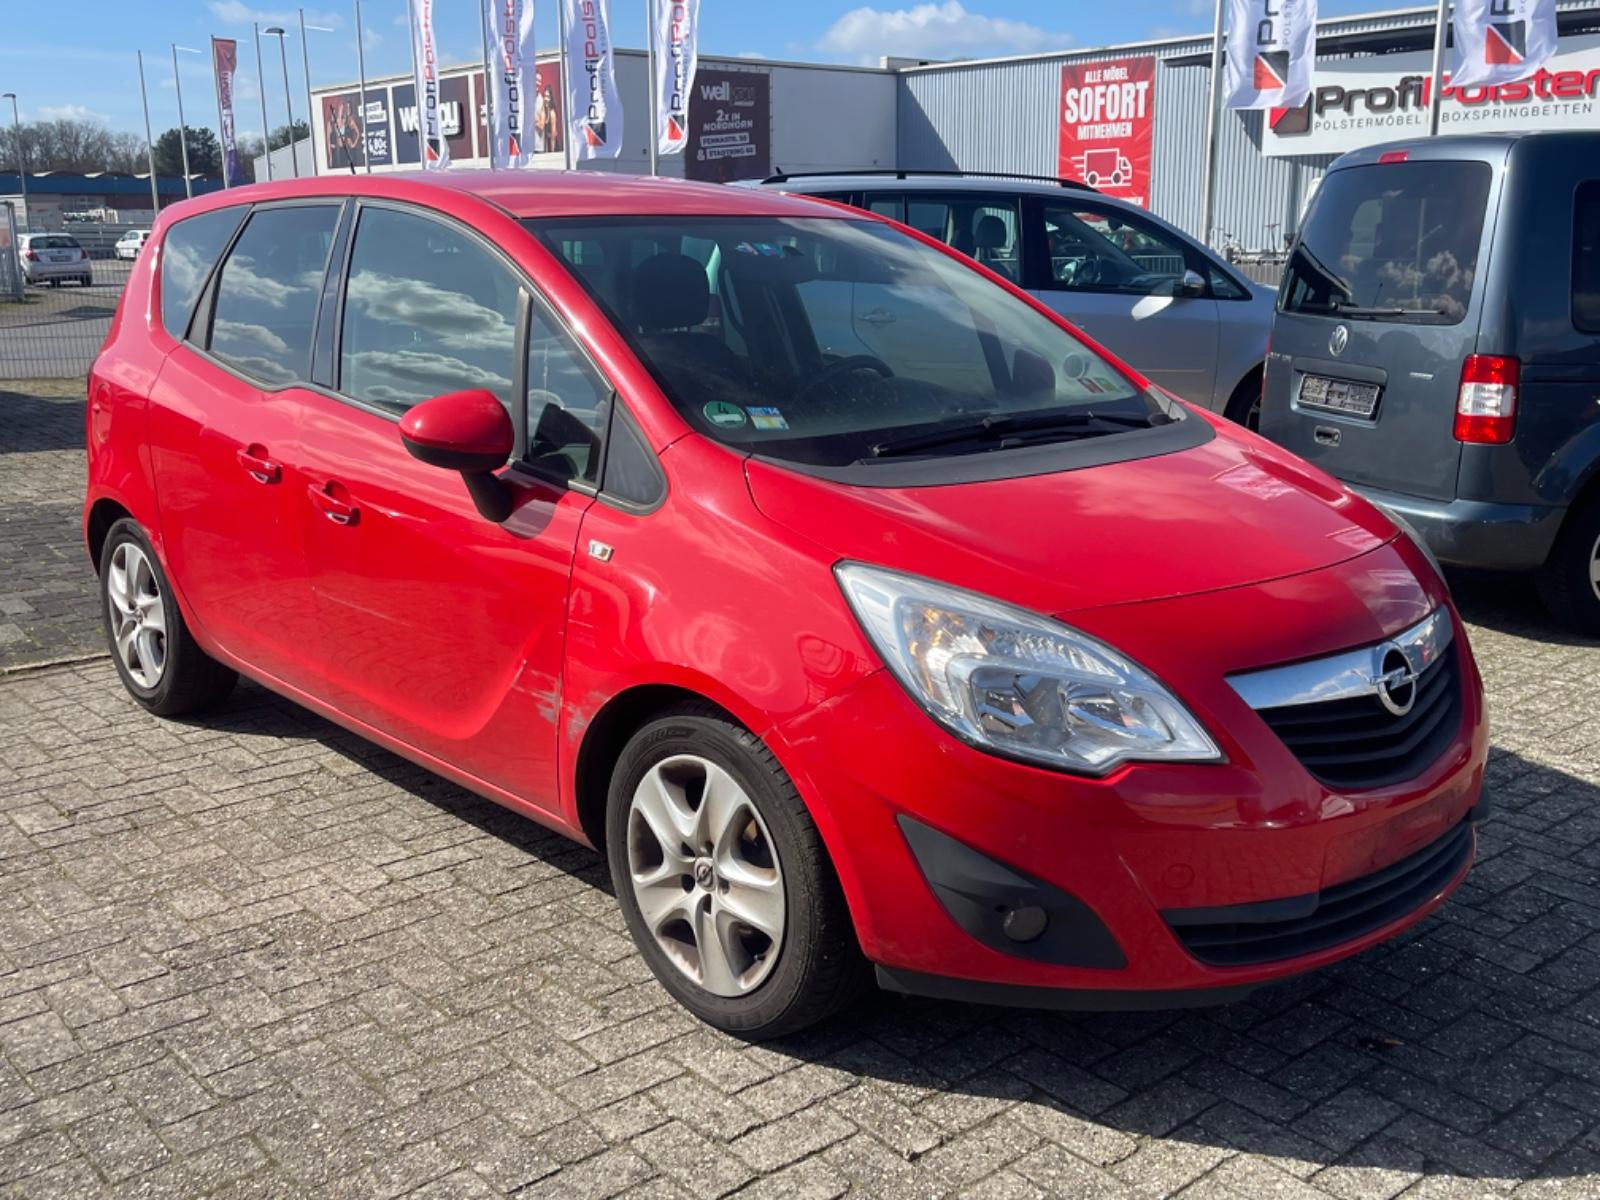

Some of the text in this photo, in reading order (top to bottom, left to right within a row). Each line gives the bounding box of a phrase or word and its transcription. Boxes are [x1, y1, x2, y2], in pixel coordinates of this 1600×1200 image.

[1085, 66, 1128, 83] ALLE MÖBEL
[1065, 81, 1149, 123] SOFORT
[1314, 103, 1592, 131] POLSTERMÖBEL BOXSPRINGBETTEN
[1077, 122, 1133, 140] MITNEHMEN
